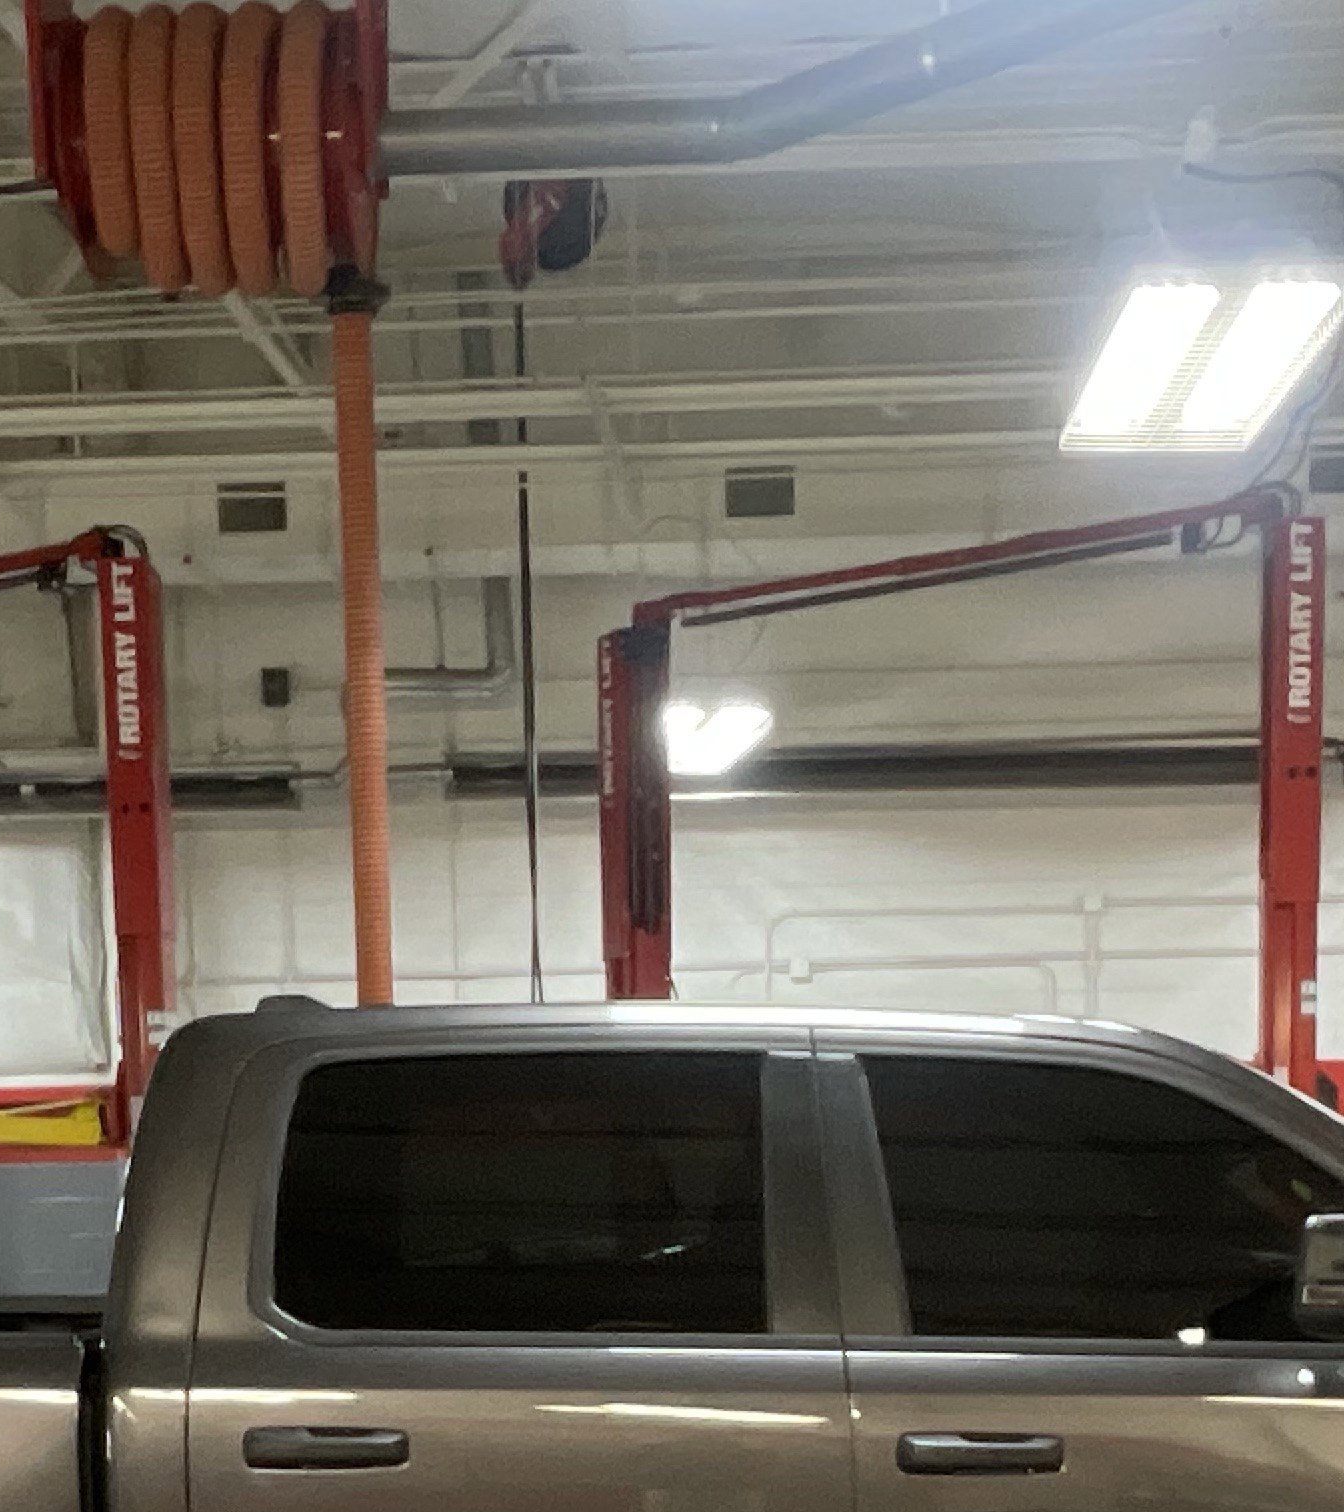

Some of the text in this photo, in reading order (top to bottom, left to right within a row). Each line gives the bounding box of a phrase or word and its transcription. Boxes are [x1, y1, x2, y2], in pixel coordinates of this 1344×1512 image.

[110, 561, 142, 744] ROTARY LIFT
[1288, 522, 1314, 708] ROTARY LIFT
